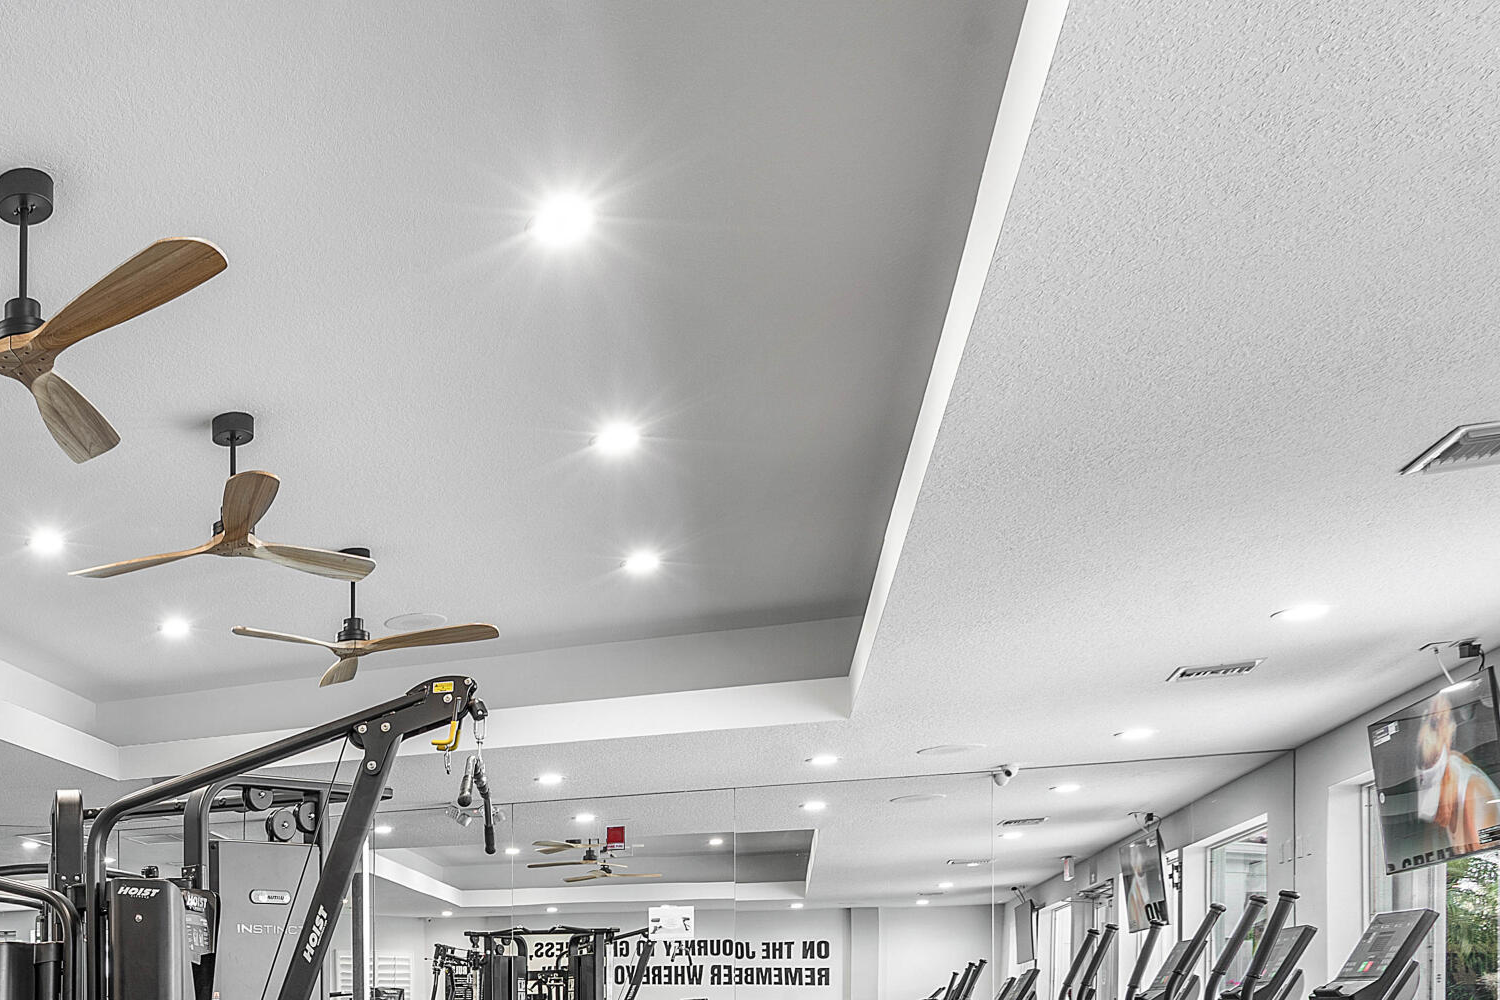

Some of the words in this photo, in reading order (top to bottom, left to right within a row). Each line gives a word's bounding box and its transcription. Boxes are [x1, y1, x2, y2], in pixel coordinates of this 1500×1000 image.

[117, 886, 161, 897] HOIST
[186, 894, 208, 908] HOIST
[303, 904, 328, 963] HOIST
